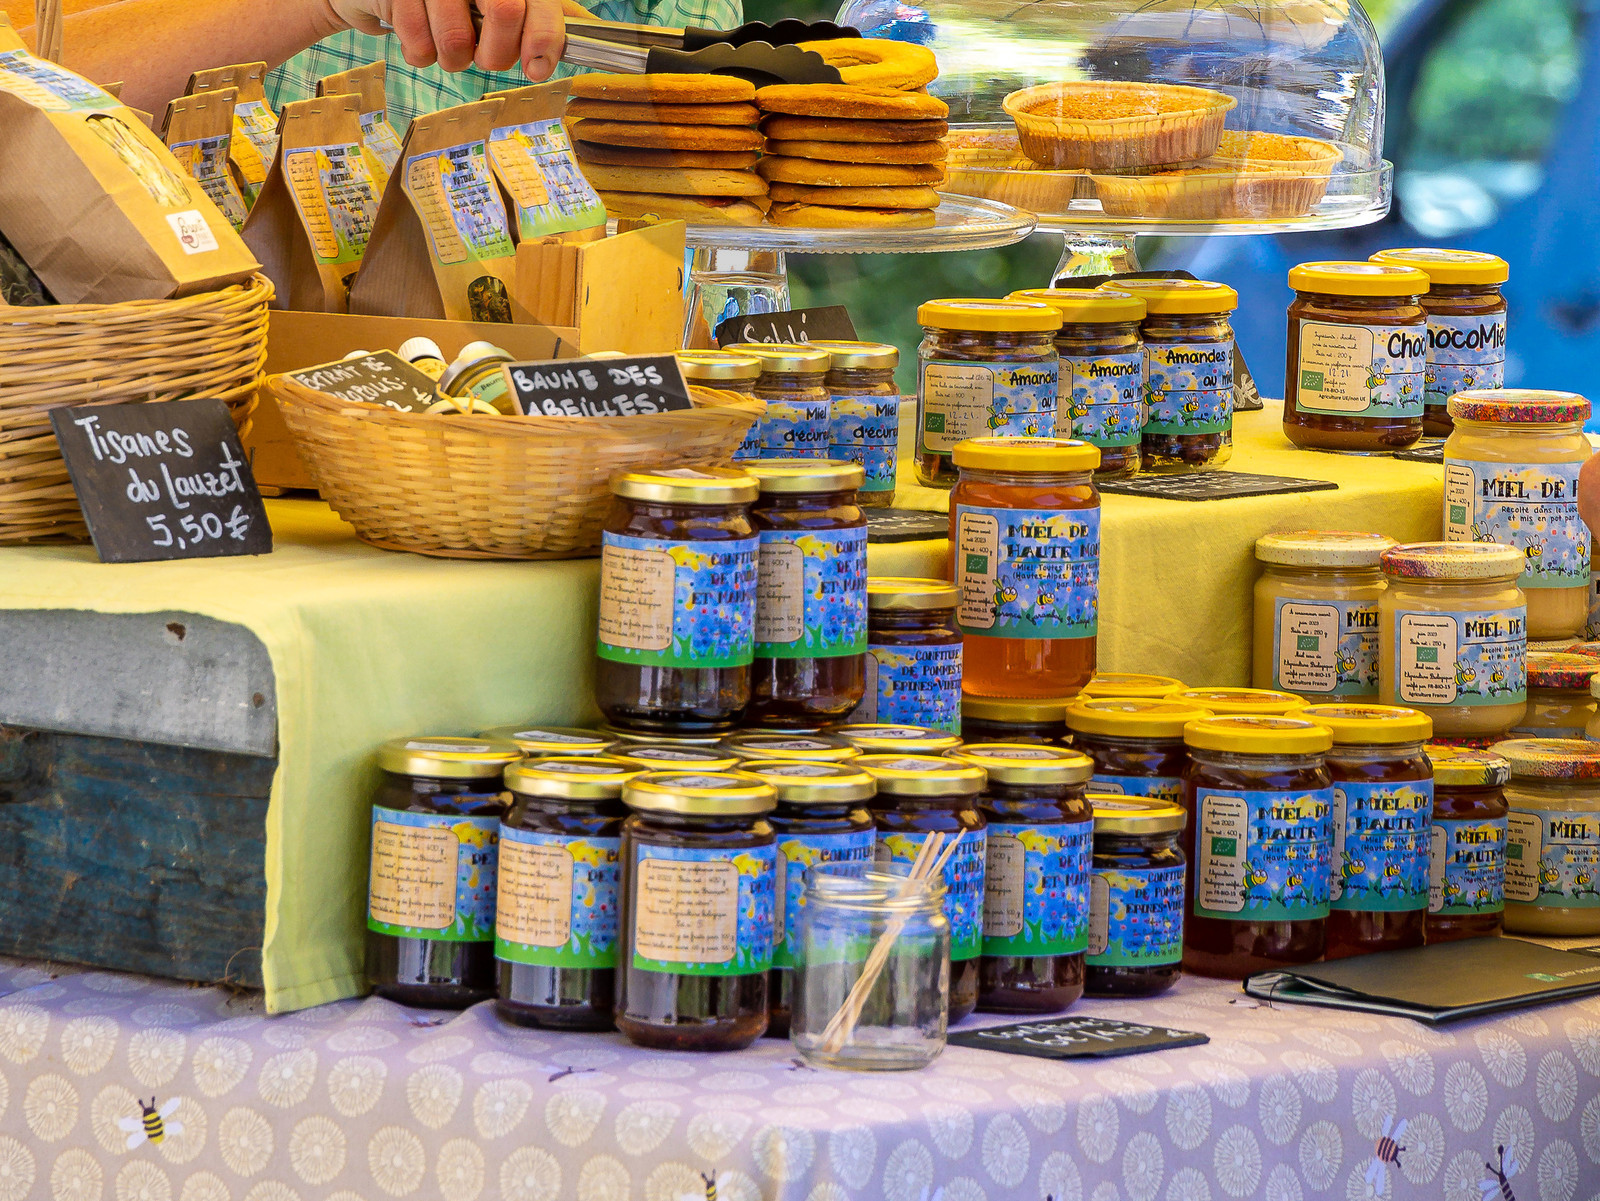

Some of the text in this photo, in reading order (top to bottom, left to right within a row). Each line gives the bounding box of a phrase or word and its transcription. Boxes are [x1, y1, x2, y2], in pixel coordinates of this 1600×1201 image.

[1165, 349, 1226, 364] Amandes
[608, 365, 664, 387] DES
[1089, 360, 1140, 377] Amandes
[1009, 369, 1058, 386] Amandes
[1203, 376, 1218, 387] au
[806, 405, 827, 420] Miel
[876, 403, 897, 417] Miel
[74, 415, 194, 464] Tisanes
[126, 441, 246, 510] du Lauzet
[1482, 478, 1530, 499] MIEL
[1541, 480, 1565, 499] DE
[1534, 505, 1553, 514] dans
[1550, 515, 1562, 523] pot
[146, 504, 251, 551] 5,50€
[1008, 524, 1090, 538] MIEL DE
[1007, 544, 1072, 558] HAUTE
[1039, 563, 1063, 571] Toutes
[1465, 619, 1521, 638] MIEL DE
[901, 666, 917, 677] DE
[1356, 795, 1429, 810] MIEL DE
[1258, 803, 1330, 820] MIEL DE
[1355, 816, 1416, 830] HAUTE
[1550, 820, 1590, 839] MIEL
[1257, 825, 1317, 840] HAUTE
[1455, 830, 1491, 844] MIEL
